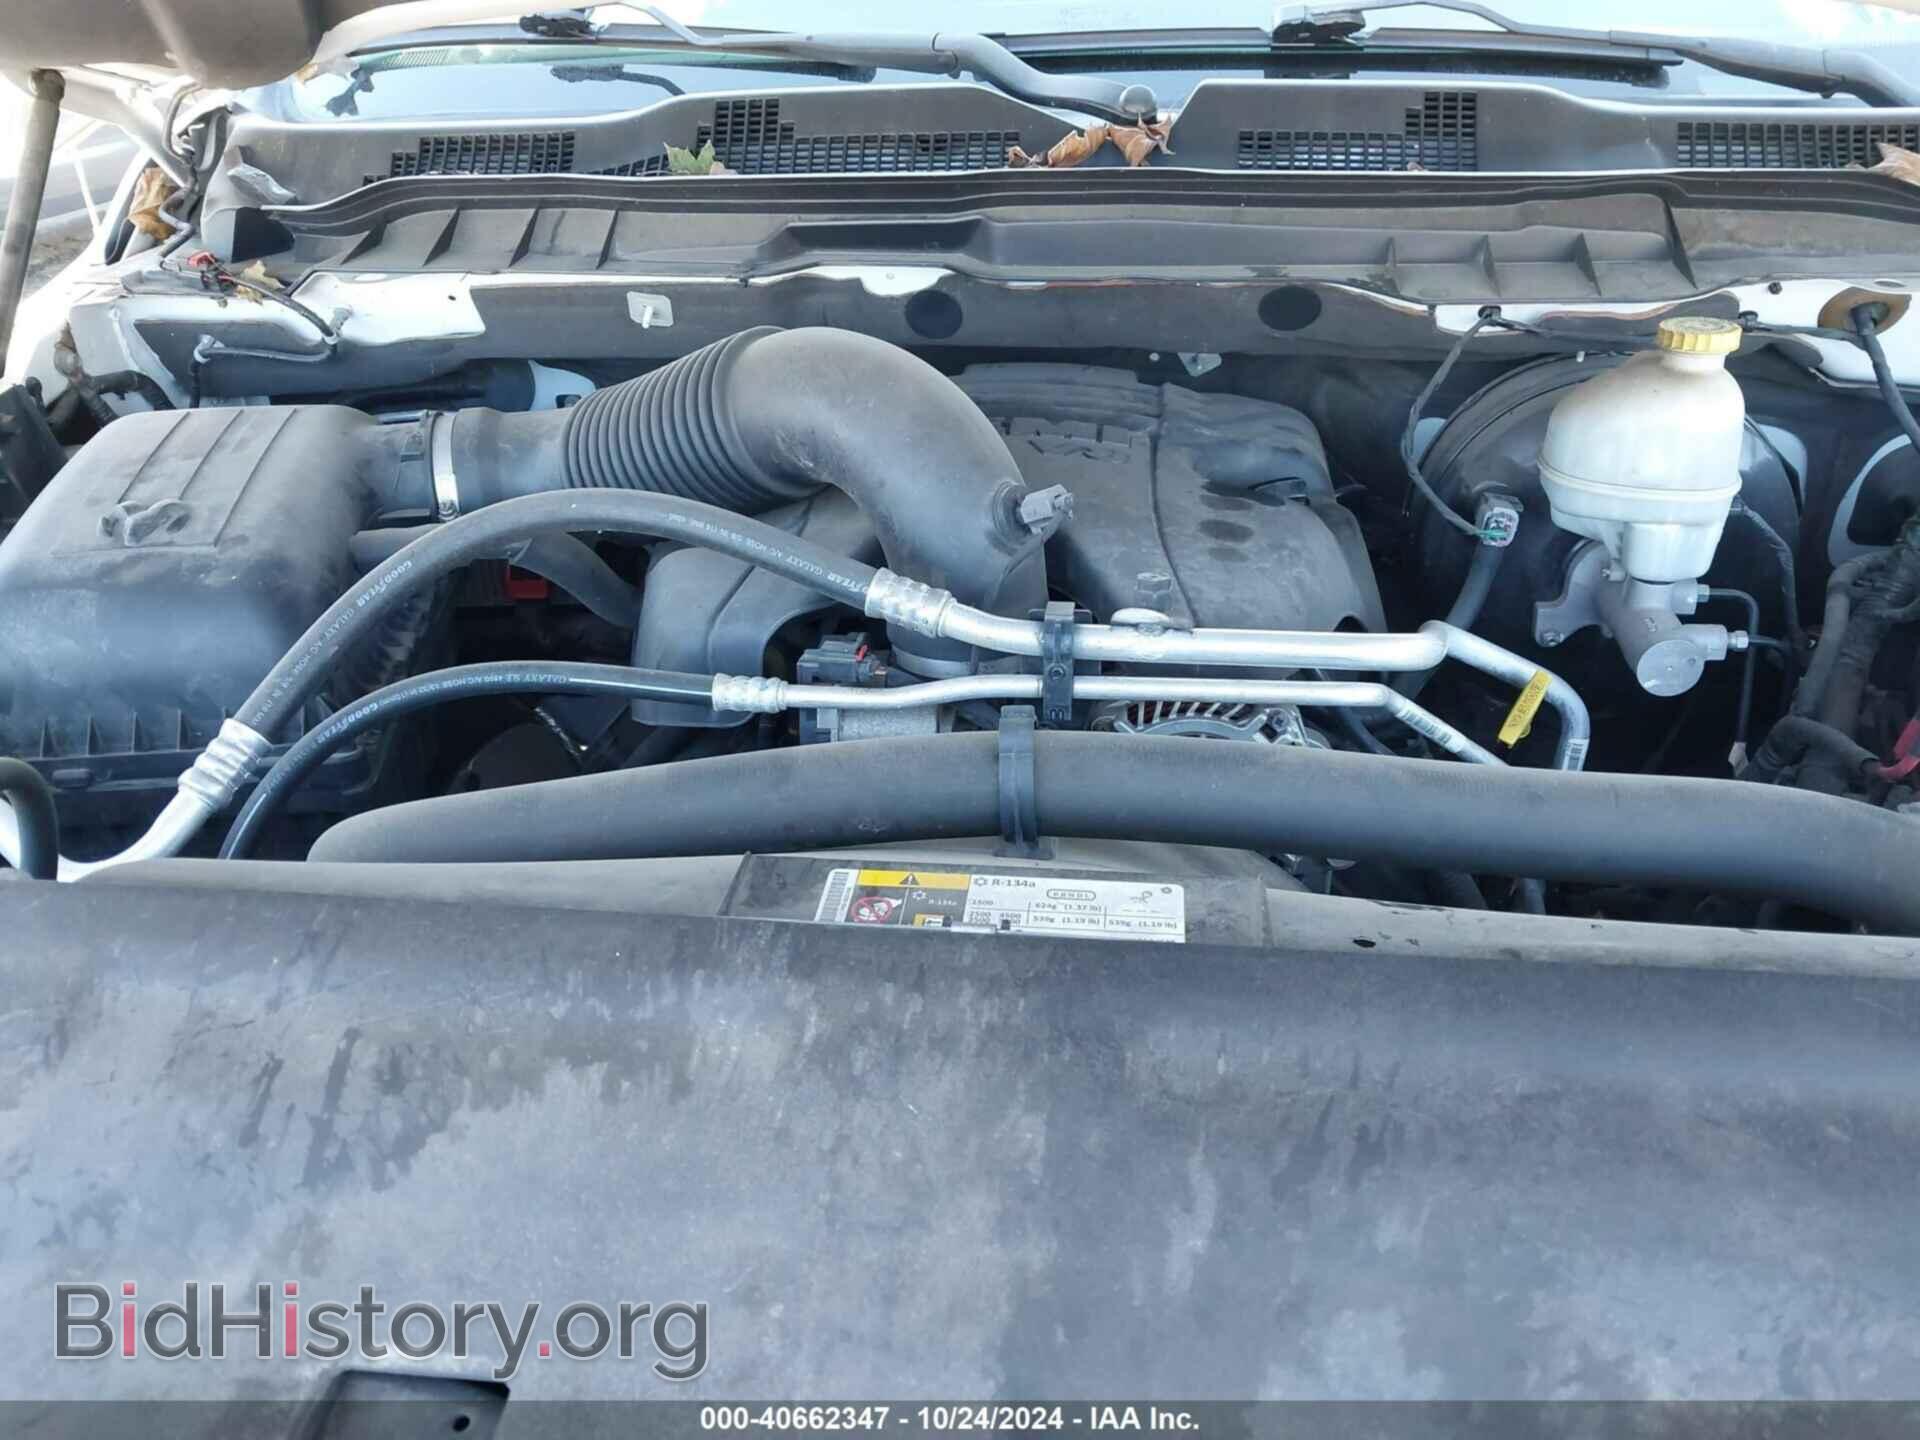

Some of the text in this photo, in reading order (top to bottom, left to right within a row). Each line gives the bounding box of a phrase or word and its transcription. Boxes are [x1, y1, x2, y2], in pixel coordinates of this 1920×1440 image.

[355, 560, 413, 608] GOODYEAR
[523, 673, 567, 684] GALAXY
[317, 702, 379, 744] GOODYEAR
[991, 879, 1036, 888] R-134a
